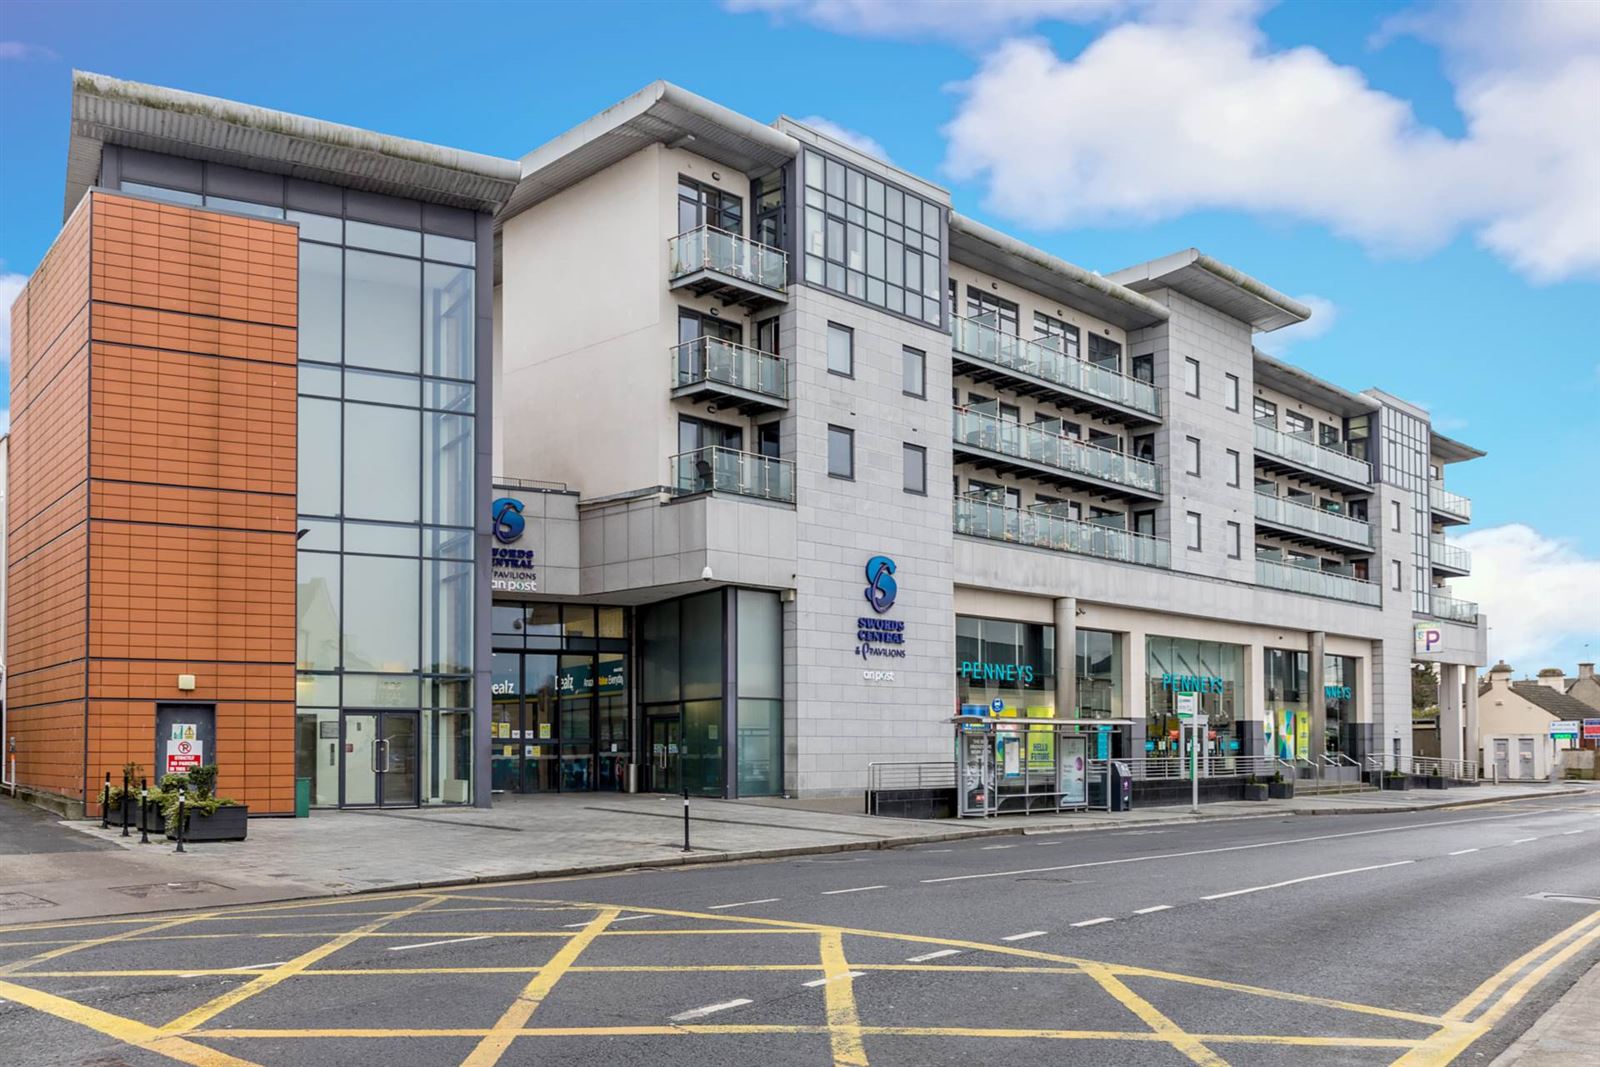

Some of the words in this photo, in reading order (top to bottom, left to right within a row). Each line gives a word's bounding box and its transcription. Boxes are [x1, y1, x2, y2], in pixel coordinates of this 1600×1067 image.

[494, 571, 537, 581] PAVILIONS
[508, 581, 537, 591] post
[857, 617, 905, 632] SWORDS
[857, 630, 905, 644] CENTRAL
[1426, 630, 1440, 651] P
[961, 661, 1034, 682] PENNEYS
[492, 680, 514, 695] ealz
[1162, 672, 1223, 695] PENNEYS
[1325, 686, 1351, 700] NNEYS
